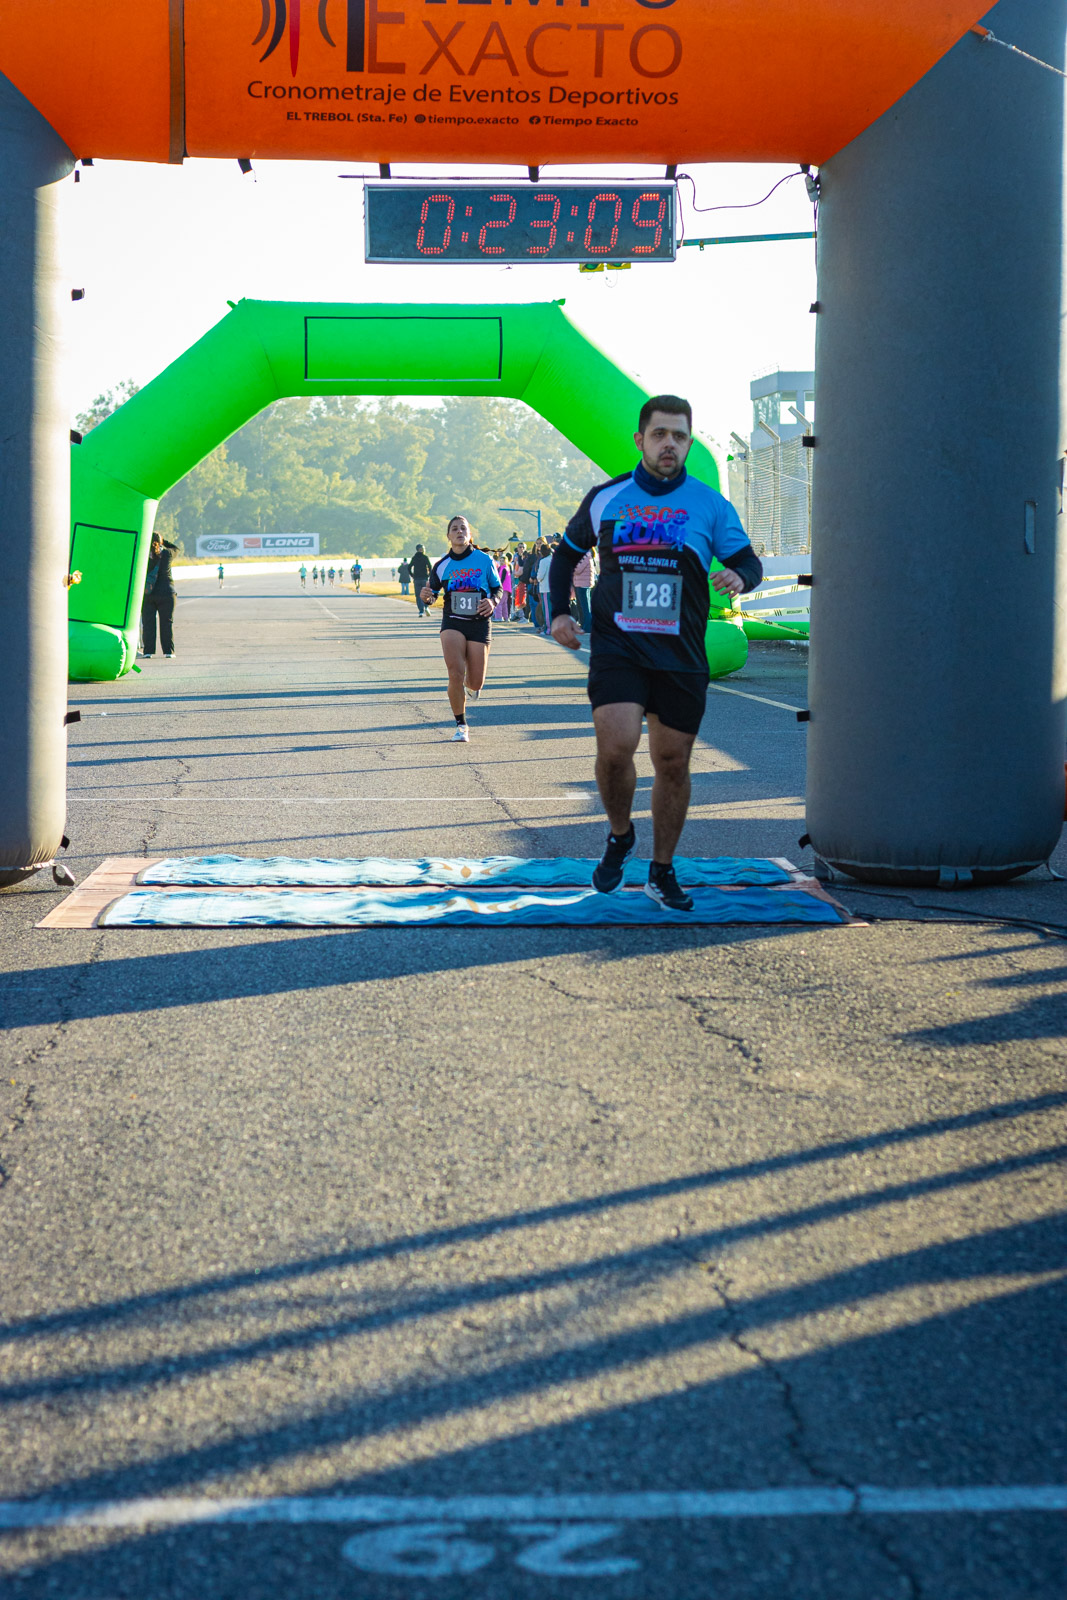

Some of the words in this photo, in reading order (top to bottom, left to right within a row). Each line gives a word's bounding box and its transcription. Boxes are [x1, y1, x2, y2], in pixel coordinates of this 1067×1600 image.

[368, 0, 683, 79] EXACTO
[247, 80, 406, 106] Cronometraje
[412, 83, 442, 102] de
[450, 84, 541, 104] Eventos
[549, 86, 679, 108] Deportivos
[286, 111, 302, 121] EL
[304, 112, 354, 122] TREBOL
[357, 112, 386, 124] (Sta.
[388, 113, 408, 124] Fe)
[428, 115, 519, 126] tiempo.exacto
[543, 115, 592, 127] Tiempo
[596, 117, 639, 126] Exacto
[417, 193, 667, 255] 0:23:09
[206, 539, 232, 551] Ford
[265, 538, 311, 547] LONG
[647, 556, 669, 568] SANTA
[669, 559, 679, 569] FE
[634, 582, 671, 607] 128
[460, 597, 472, 610] 31
